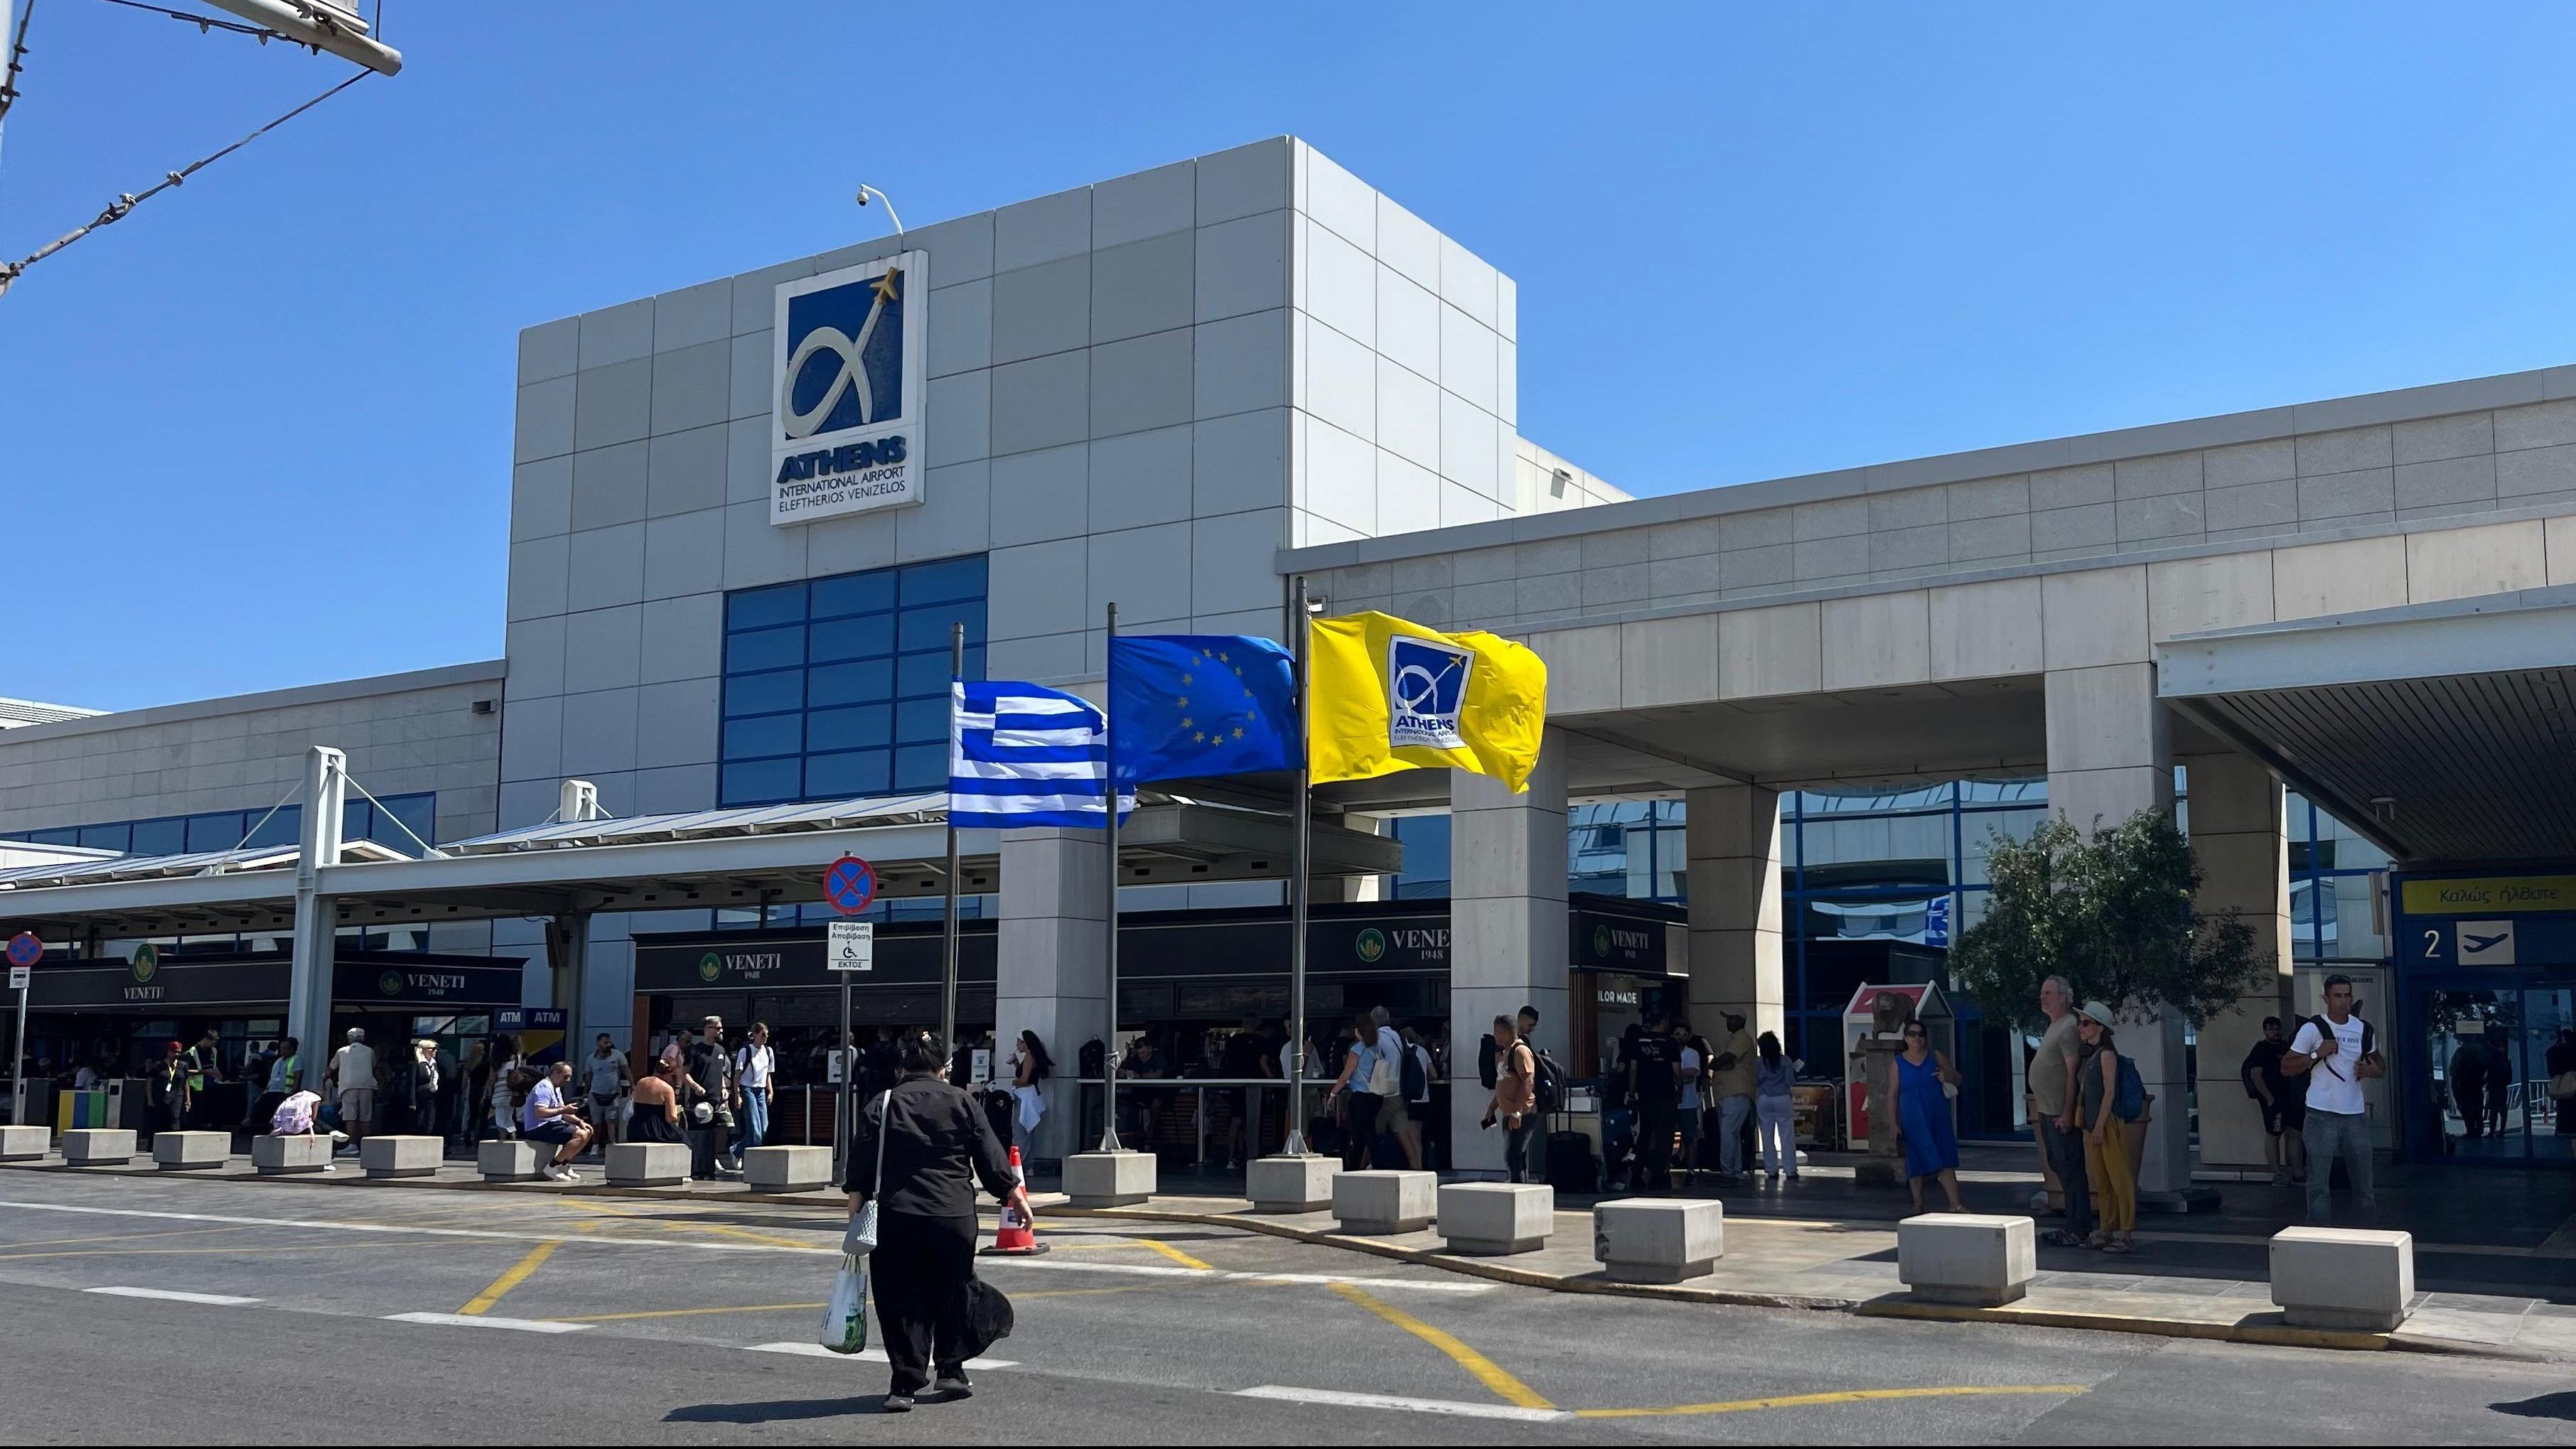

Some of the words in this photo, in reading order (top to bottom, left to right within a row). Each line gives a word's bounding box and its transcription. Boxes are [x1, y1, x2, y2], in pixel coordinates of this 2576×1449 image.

[777, 436, 907, 483] ATHENS
[780, 474, 859, 499] INTERNATIONAL
[862, 465, 906, 482] AIRPORT
[779, 491, 844, 512] ELEFTHERIOS
[848, 480, 906, 499] VENIZELOS
[1395, 715, 1455, 731] ATHENS
[2440, 888, 2491, 904] Καλώς
[1392, 929, 1450, 949] VENE
[1611, 930, 1649, 949] VENETI
[2424, 930, 2441, 957] 2
[726, 953, 780, 970] VENETI
[1421, 949, 1444, 960] 1948
[407, 974, 465, 989] VENETI
[124, 986, 163, 1000] VENETI
[1597, 990, 1615, 1003] ILOR
[1616, 991, 1638, 1004] MADE
[500, 1011, 521, 1023] ATM
[534, 1012, 560, 1023] ATM
